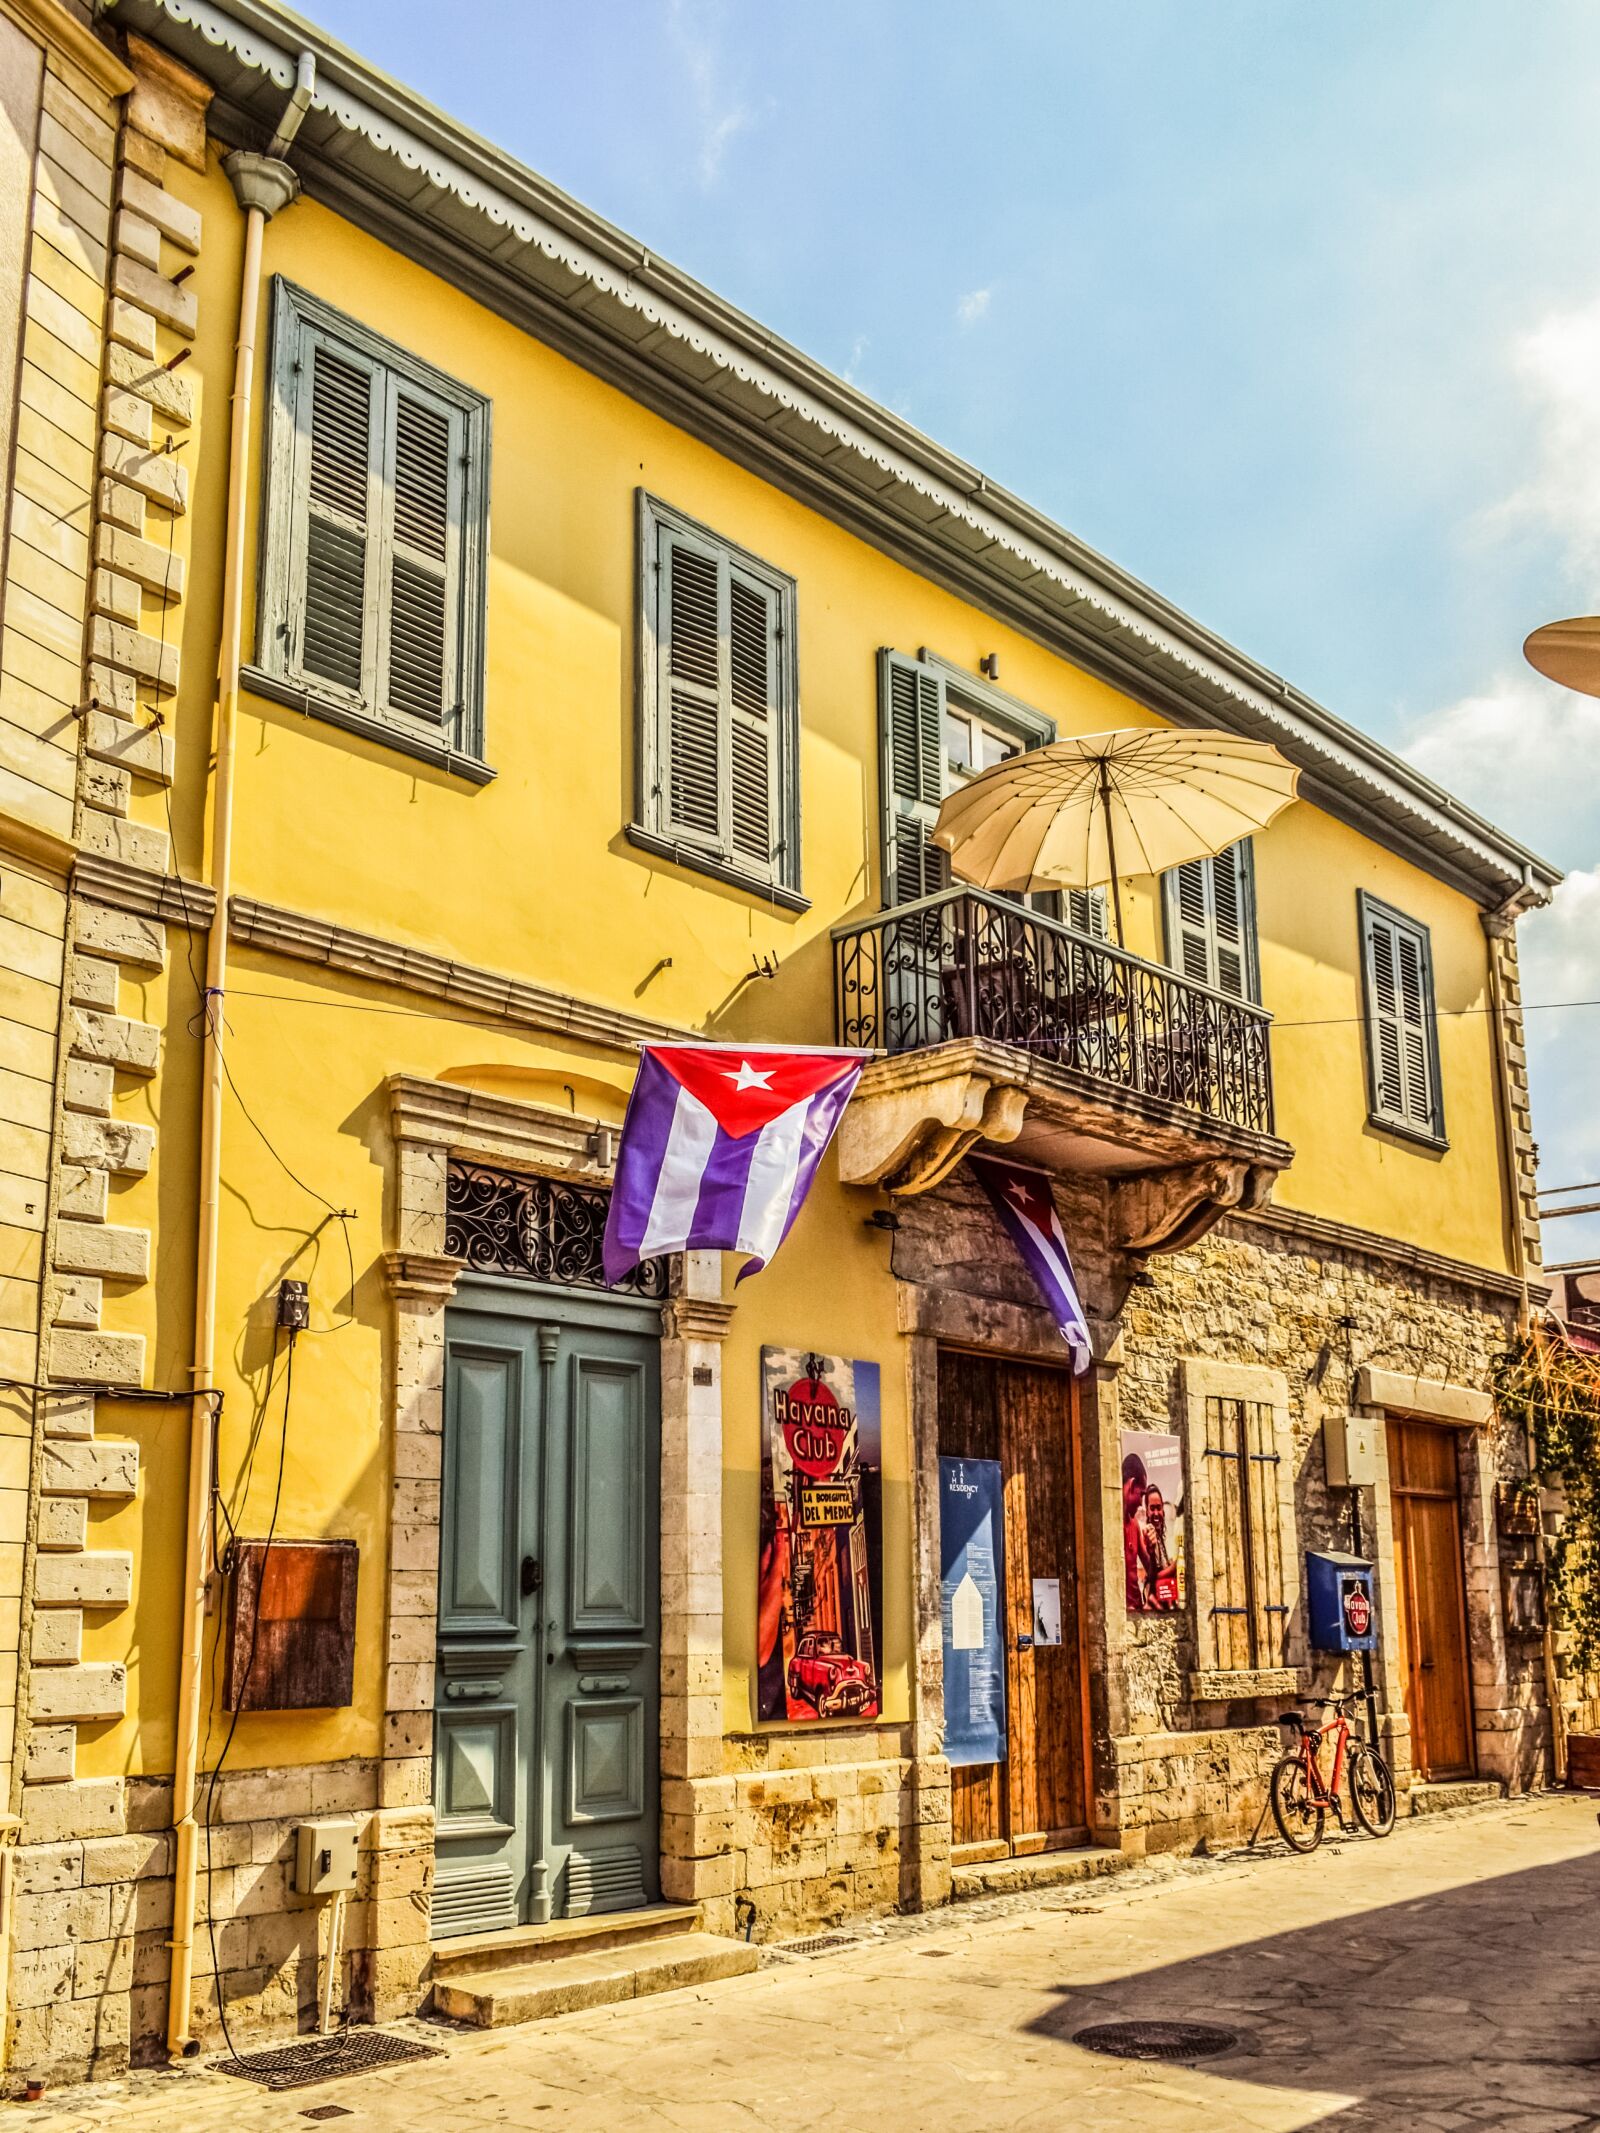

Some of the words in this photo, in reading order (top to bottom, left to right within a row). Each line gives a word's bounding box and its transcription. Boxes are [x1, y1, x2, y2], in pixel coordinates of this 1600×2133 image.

[774, 1389, 851, 1430] Havana
[793, 1429, 836, 1460] Club
[803, 1492, 813, 1503] LA
[805, 1505, 820, 1522] DEL
[823, 1504, 853, 1521] MEDIO
[1344, 1594, 1370, 1611] Havana
